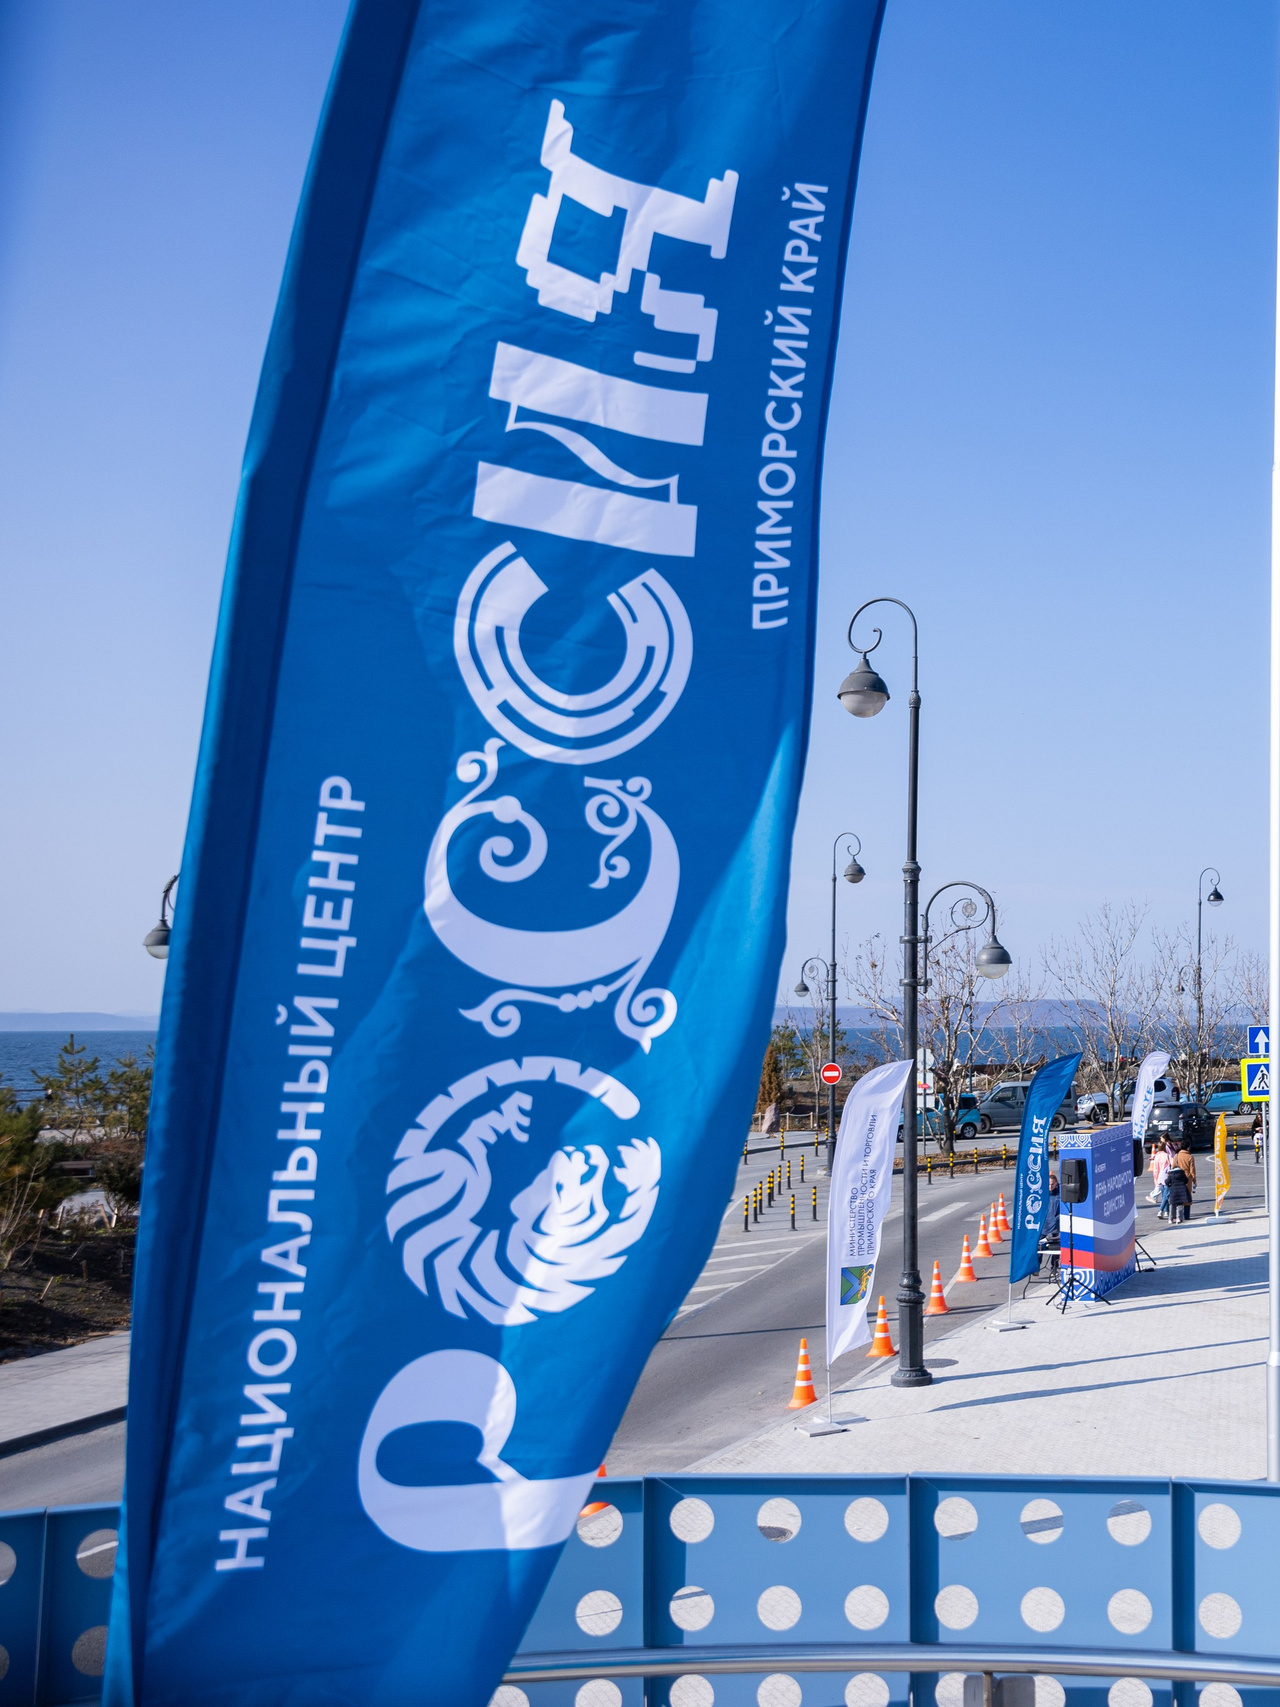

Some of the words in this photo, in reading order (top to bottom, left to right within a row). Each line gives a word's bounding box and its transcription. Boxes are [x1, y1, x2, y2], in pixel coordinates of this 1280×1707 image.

[752, 306, 812, 631] ПРИМОРСКИЙ
[782, 182, 830, 297] КРАЙ
[358, 98, 740, 1553] РОССИЯ
[862, 1160, 869, 1168] И
[864, 1114, 878, 1160] ТОРГОВЛИ
[215, 996, 339, 1573] НАЦИОНАЛЬНЫЙ
[296, 775, 366, 979] ЦЕНТР
[869, 1169, 877, 1188] КРАЯ
[1024, 1114, 1048, 1232] РОССИЯ
[1095, 1183, 1107, 1201] ДЕНЬ
[1107, 1170, 1133, 1192] НАРОДНОГО
[1103, 1194, 1126, 1218] ЕДИНСТВА
[850, 1187, 859, 1257] МИНИСТЕРСТВО
[857, 1169, 869, 1256] ПРОМЫШЛЕННОСТИ
[866, 1191, 876, 1255] ПРИМОРСКОГО
